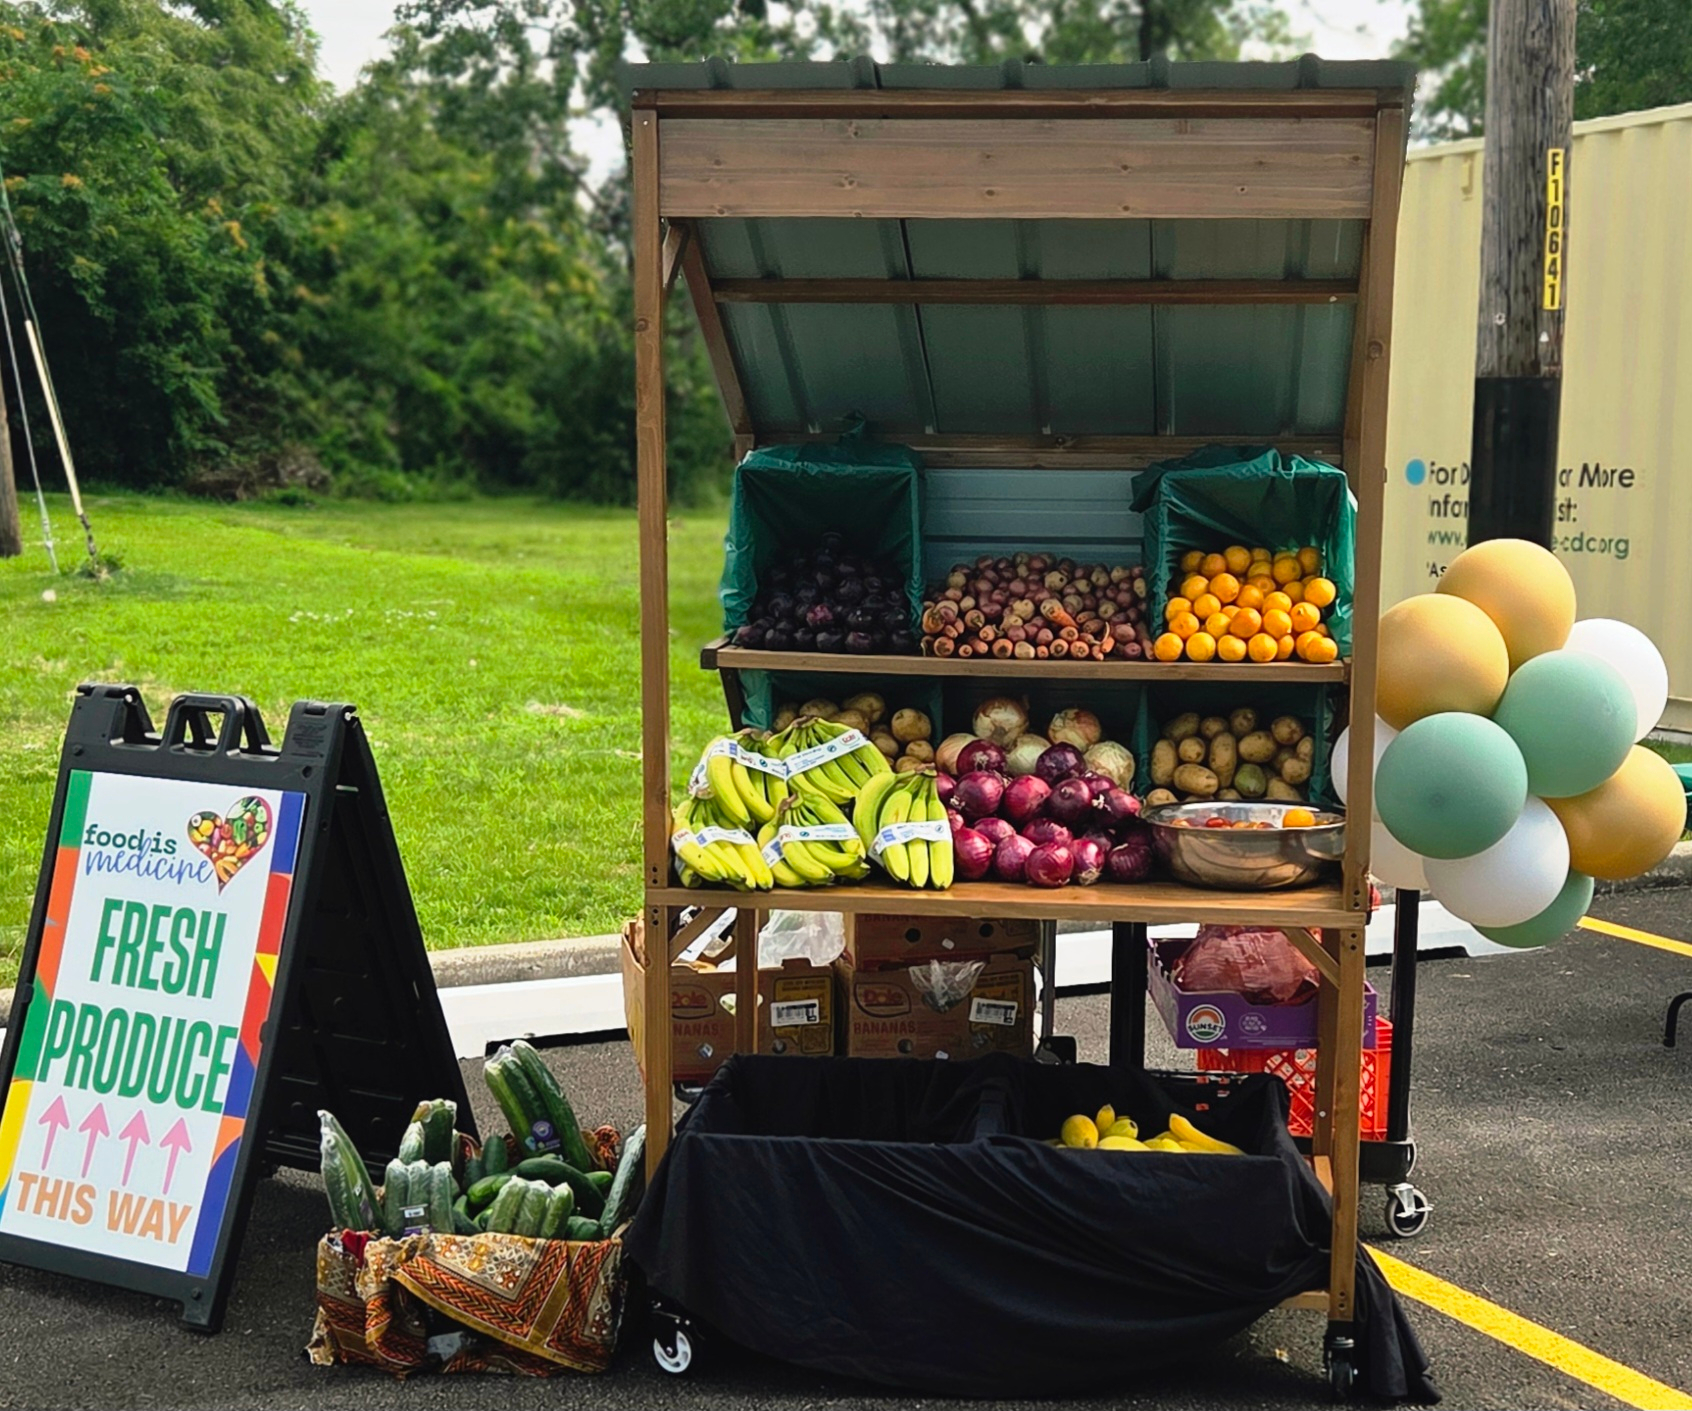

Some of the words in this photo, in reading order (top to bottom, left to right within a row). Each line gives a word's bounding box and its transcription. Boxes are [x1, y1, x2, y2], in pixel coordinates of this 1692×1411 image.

[1547, 152, 1560, 306] F10641
[1429, 461, 1457, 486] For
[1578, 462, 1636, 489] More
[84, 824, 145, 851] food
[151, 832, 177, 855] is
[86, 837, 214, 885] medicine
[90, 898, 228, 999] FRESH
[863, 989, 903, 1004] Dole
[674, 1024, 720, 1037] NANAS
[853, 1020, 916, 1035] BANANAS
[1188, 1022, 1224, 1033] SUNSET
[37, 999, 239, 1114] PRODUCE
[17, 1172, 97, 1226] THIS
[107, 1190, 193, 1244] WAY
